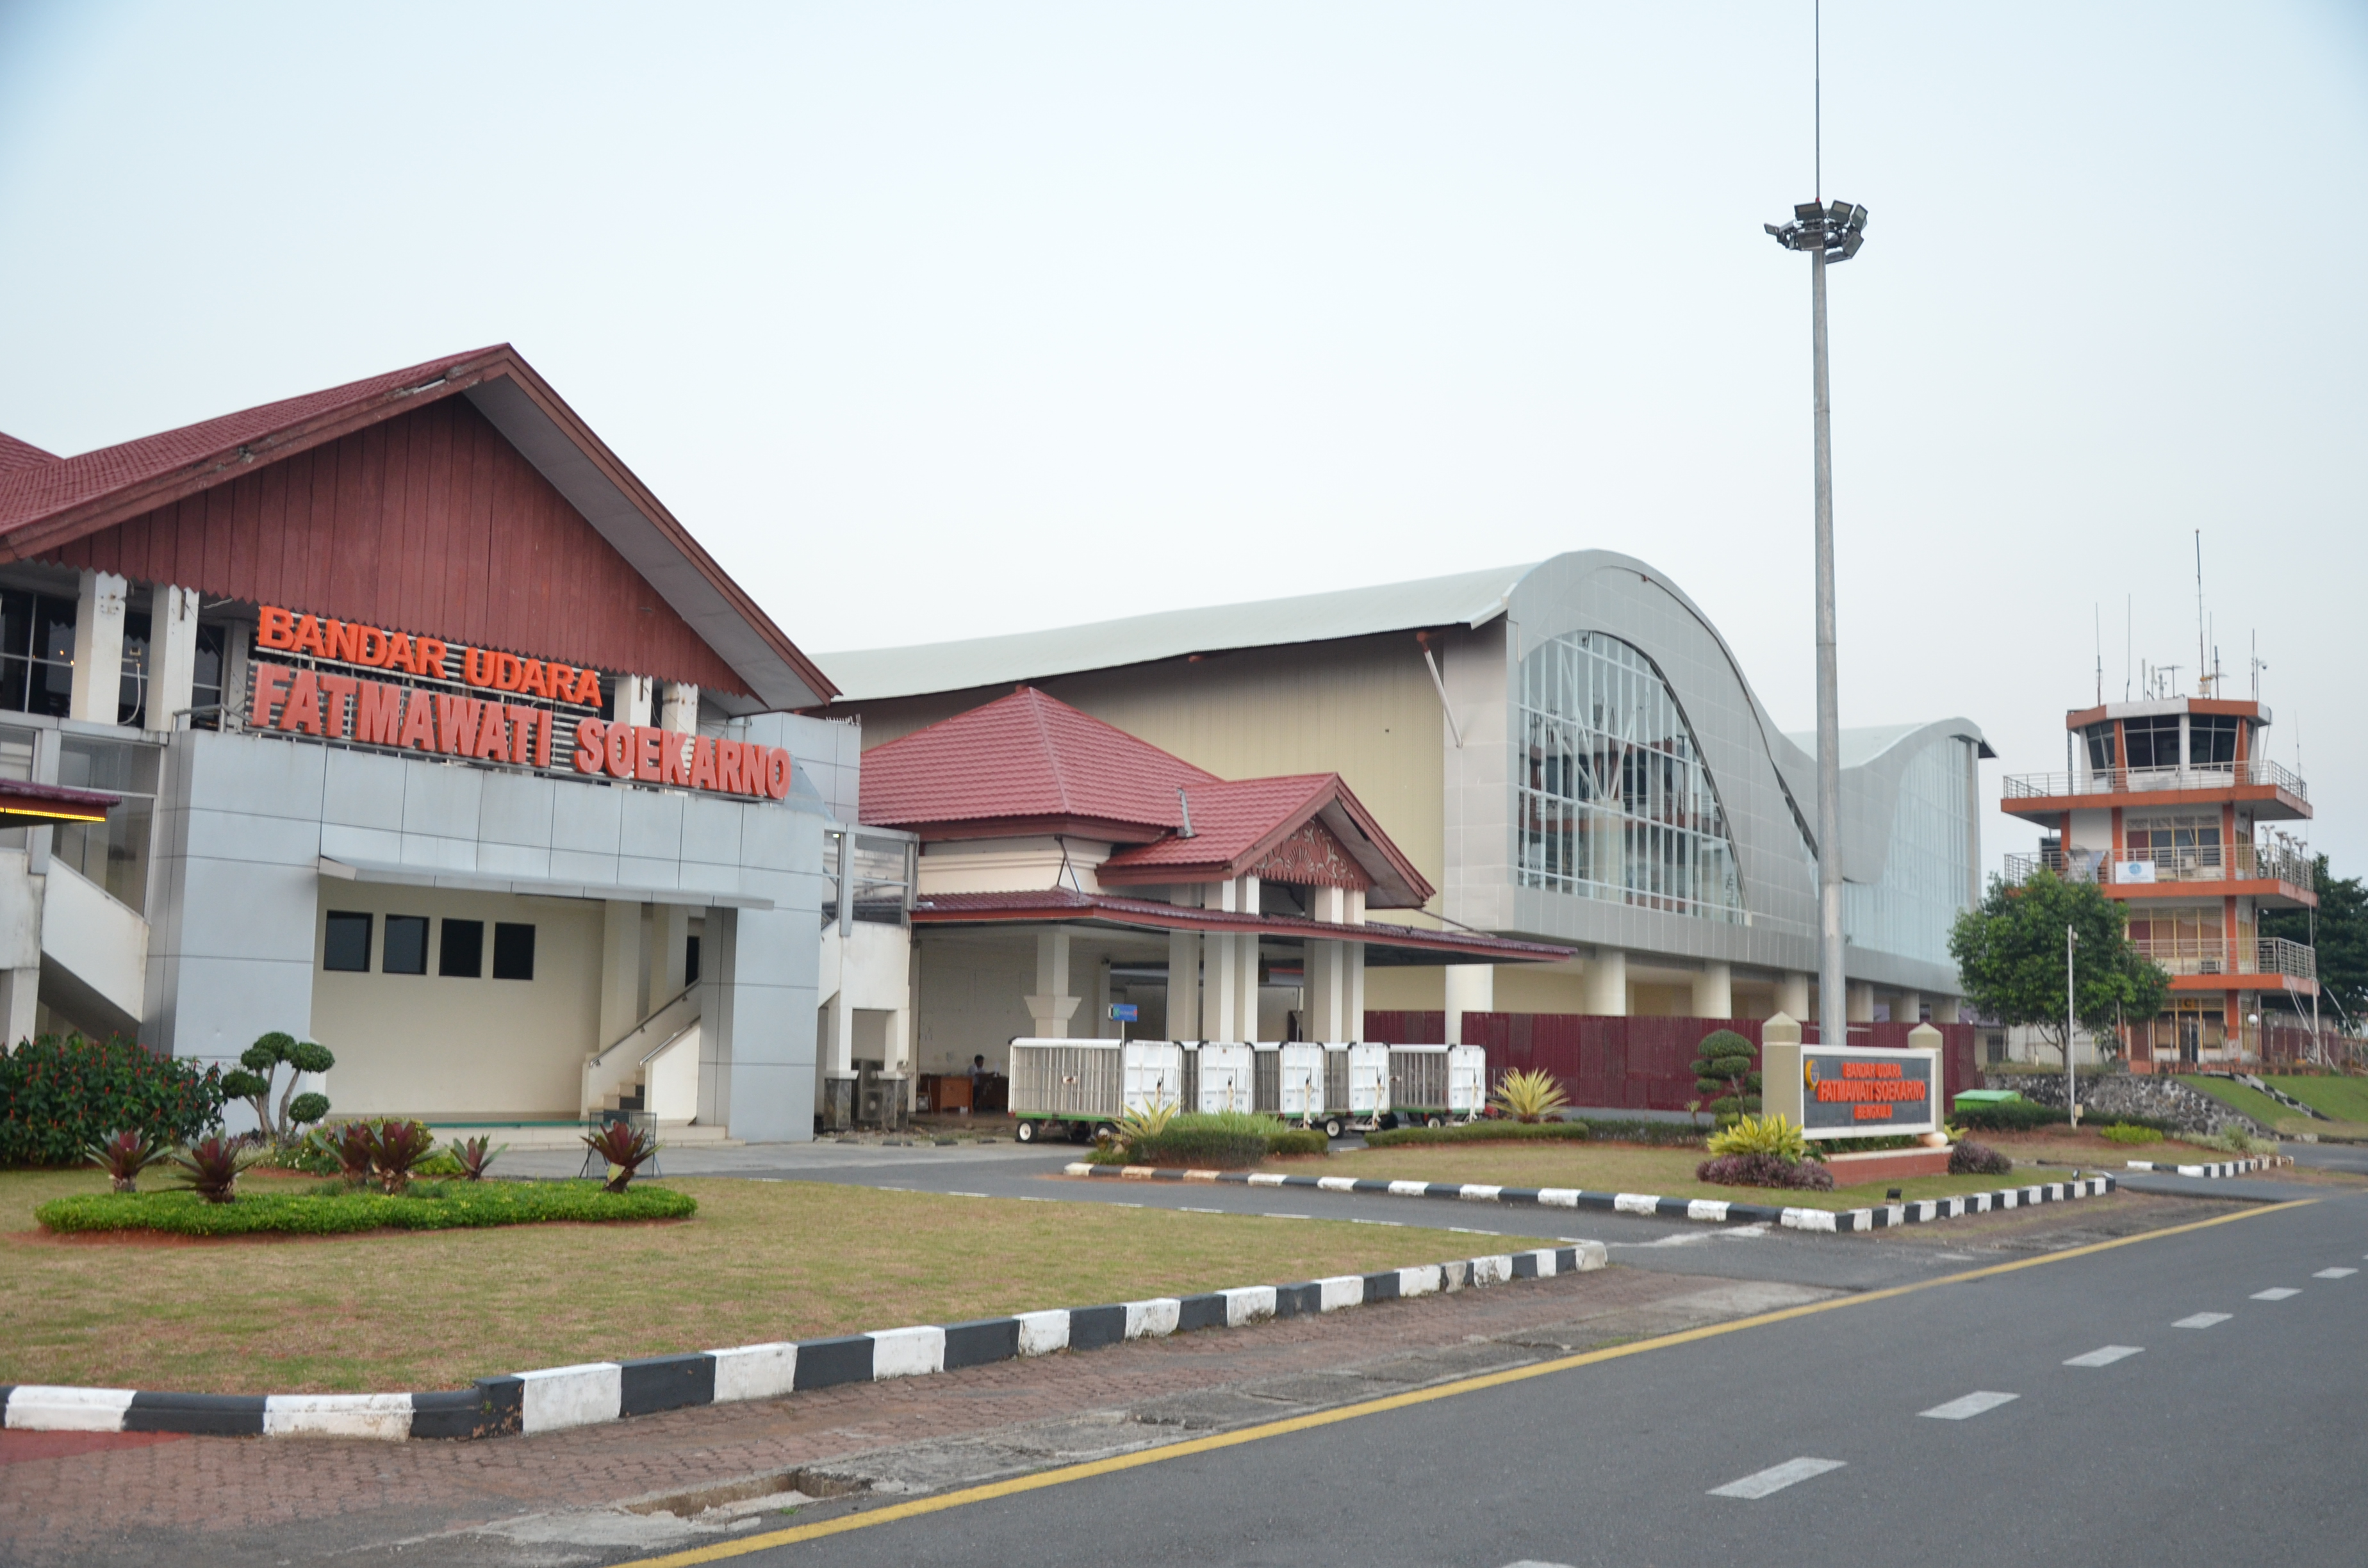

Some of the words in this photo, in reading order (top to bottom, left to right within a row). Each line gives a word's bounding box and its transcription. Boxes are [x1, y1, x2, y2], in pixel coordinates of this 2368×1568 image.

[258, 606, 447, 679] BANDAR
[465, 647, 603, 707] UDARA
[252, 663, 552, 767] FATMAWATI
[574, 717, 791, 799] SOEKARNO
[1843, 1063, 1875, 1078] BANDAR
[1875, 1063, 1902, 1078] UDARA
[1818, 1080, 1873, 1102] FATMAWATI
[1873, 1080, 1925, 1102] SOEKARNO
[1854, 1104, 1893, 1119] BENGKULU
